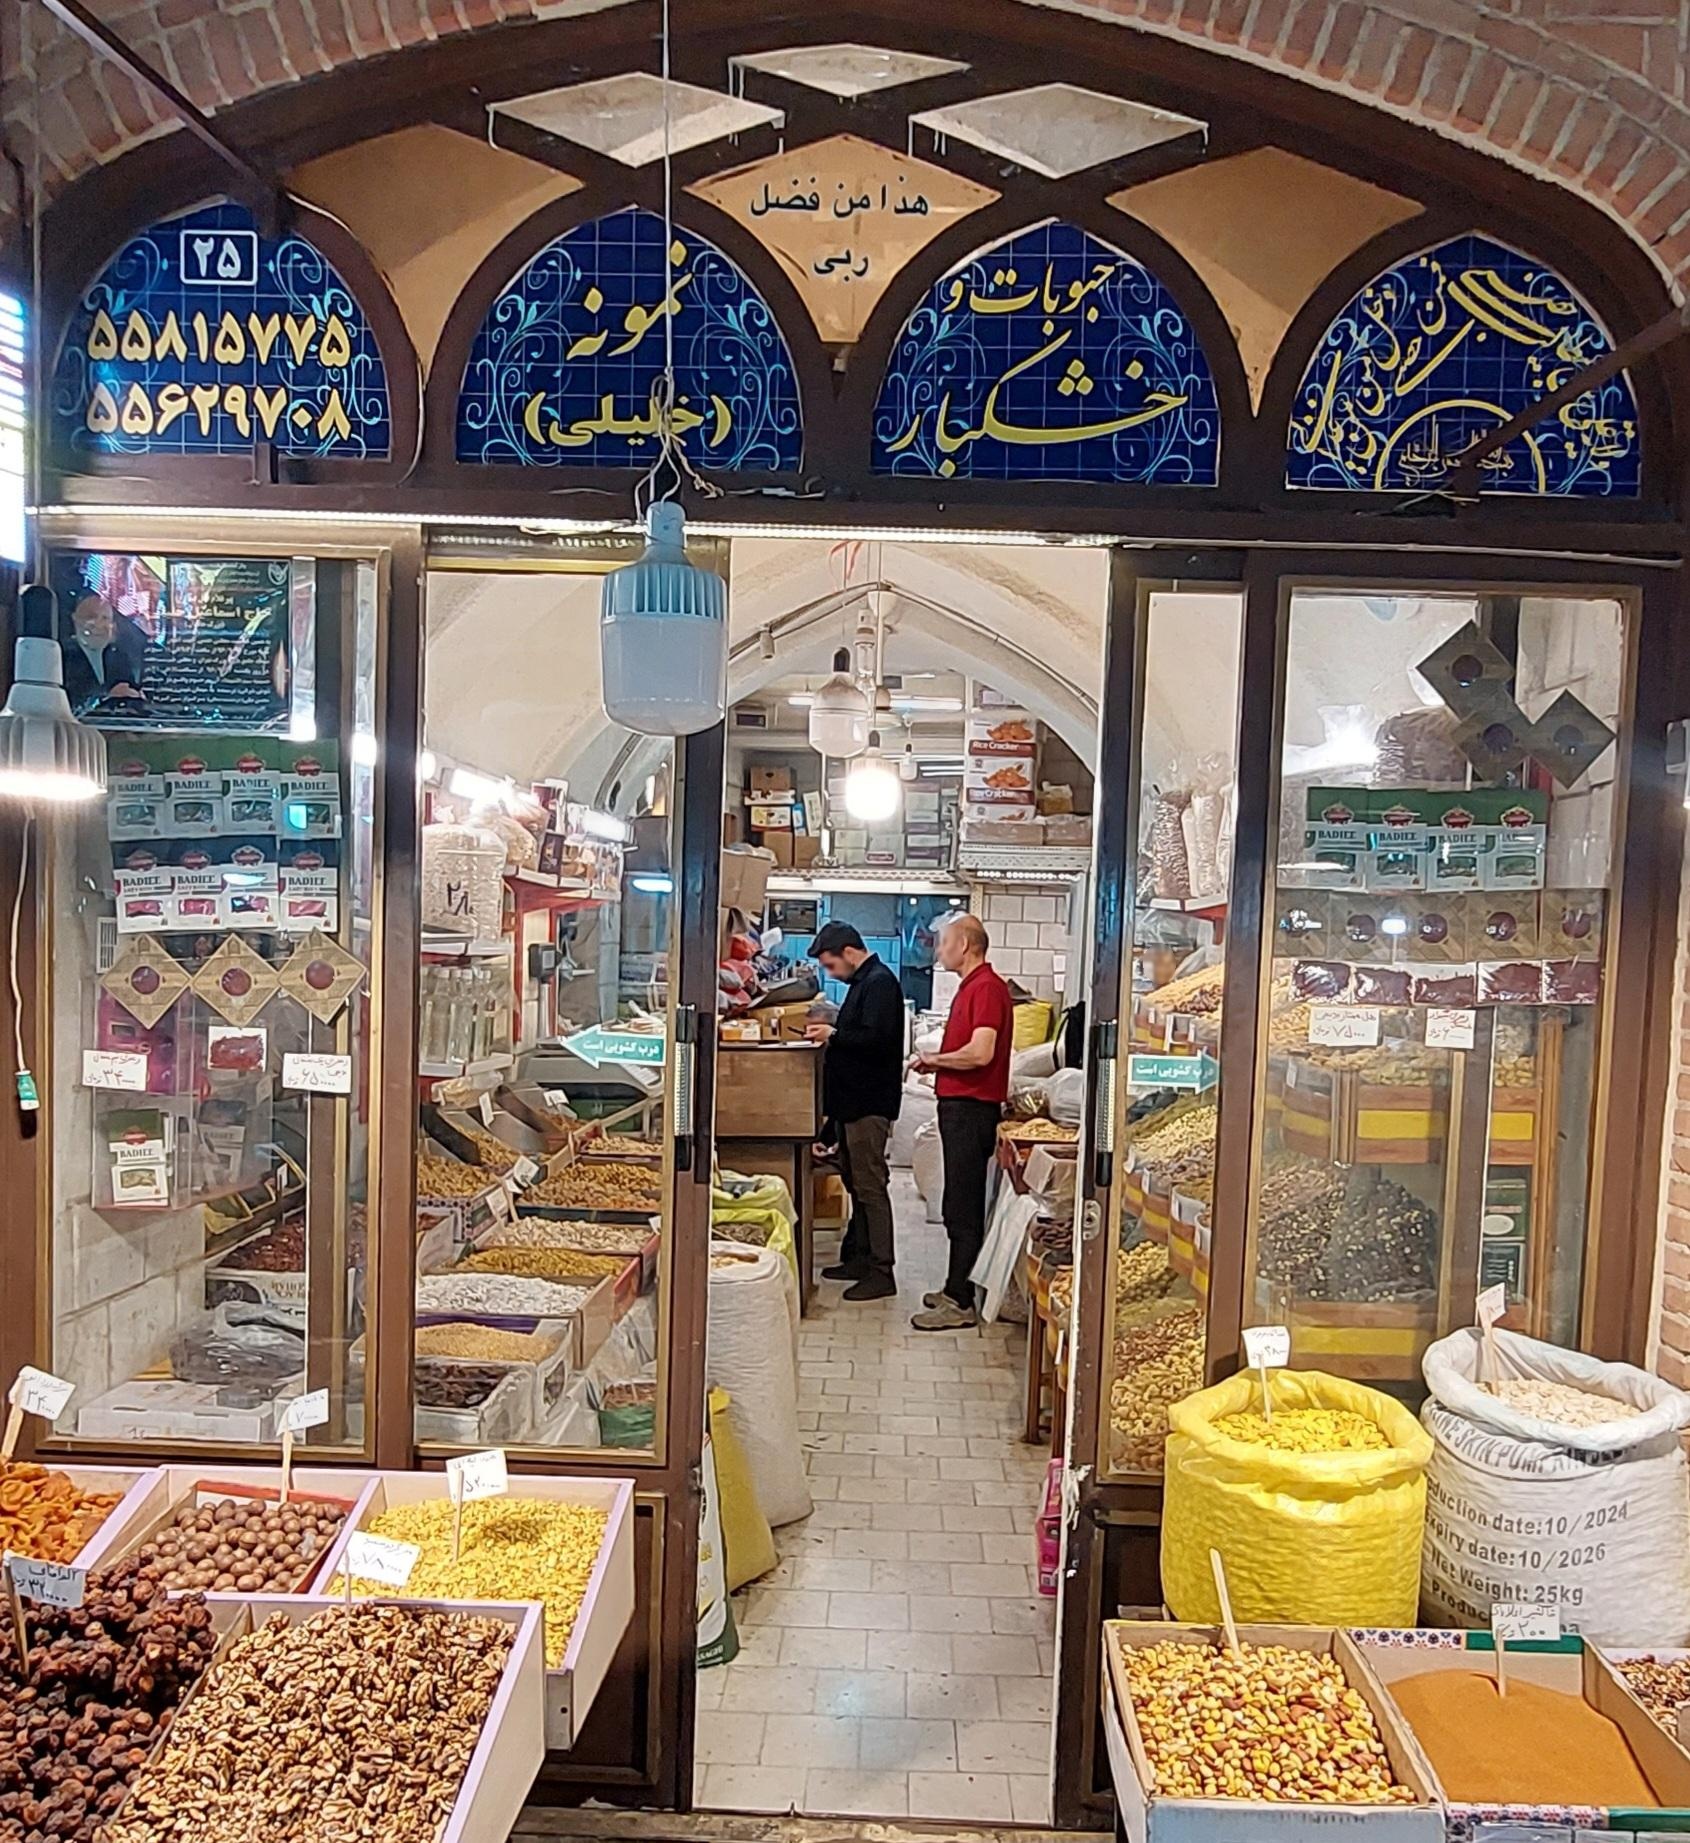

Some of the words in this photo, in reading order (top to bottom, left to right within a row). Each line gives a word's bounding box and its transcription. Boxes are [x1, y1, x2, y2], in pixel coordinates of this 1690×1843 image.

[751, 176, 820, 215] فضل
[833, 183, 870, 217] من
[192, 237, 241, 278] ۲۵
[942, 278, 964, 313] و
[969, 261, 1115, 336] حبوبات
[88, 310, 351, 367] ۵۵۸۱۵۷۷۵
[86, 382, 351, 440] ۵۵۶۲۹۷۰۸
[886, 330, 1188, 477] خشکبار
[1534, 1584, 1584, 1606] 25kg
